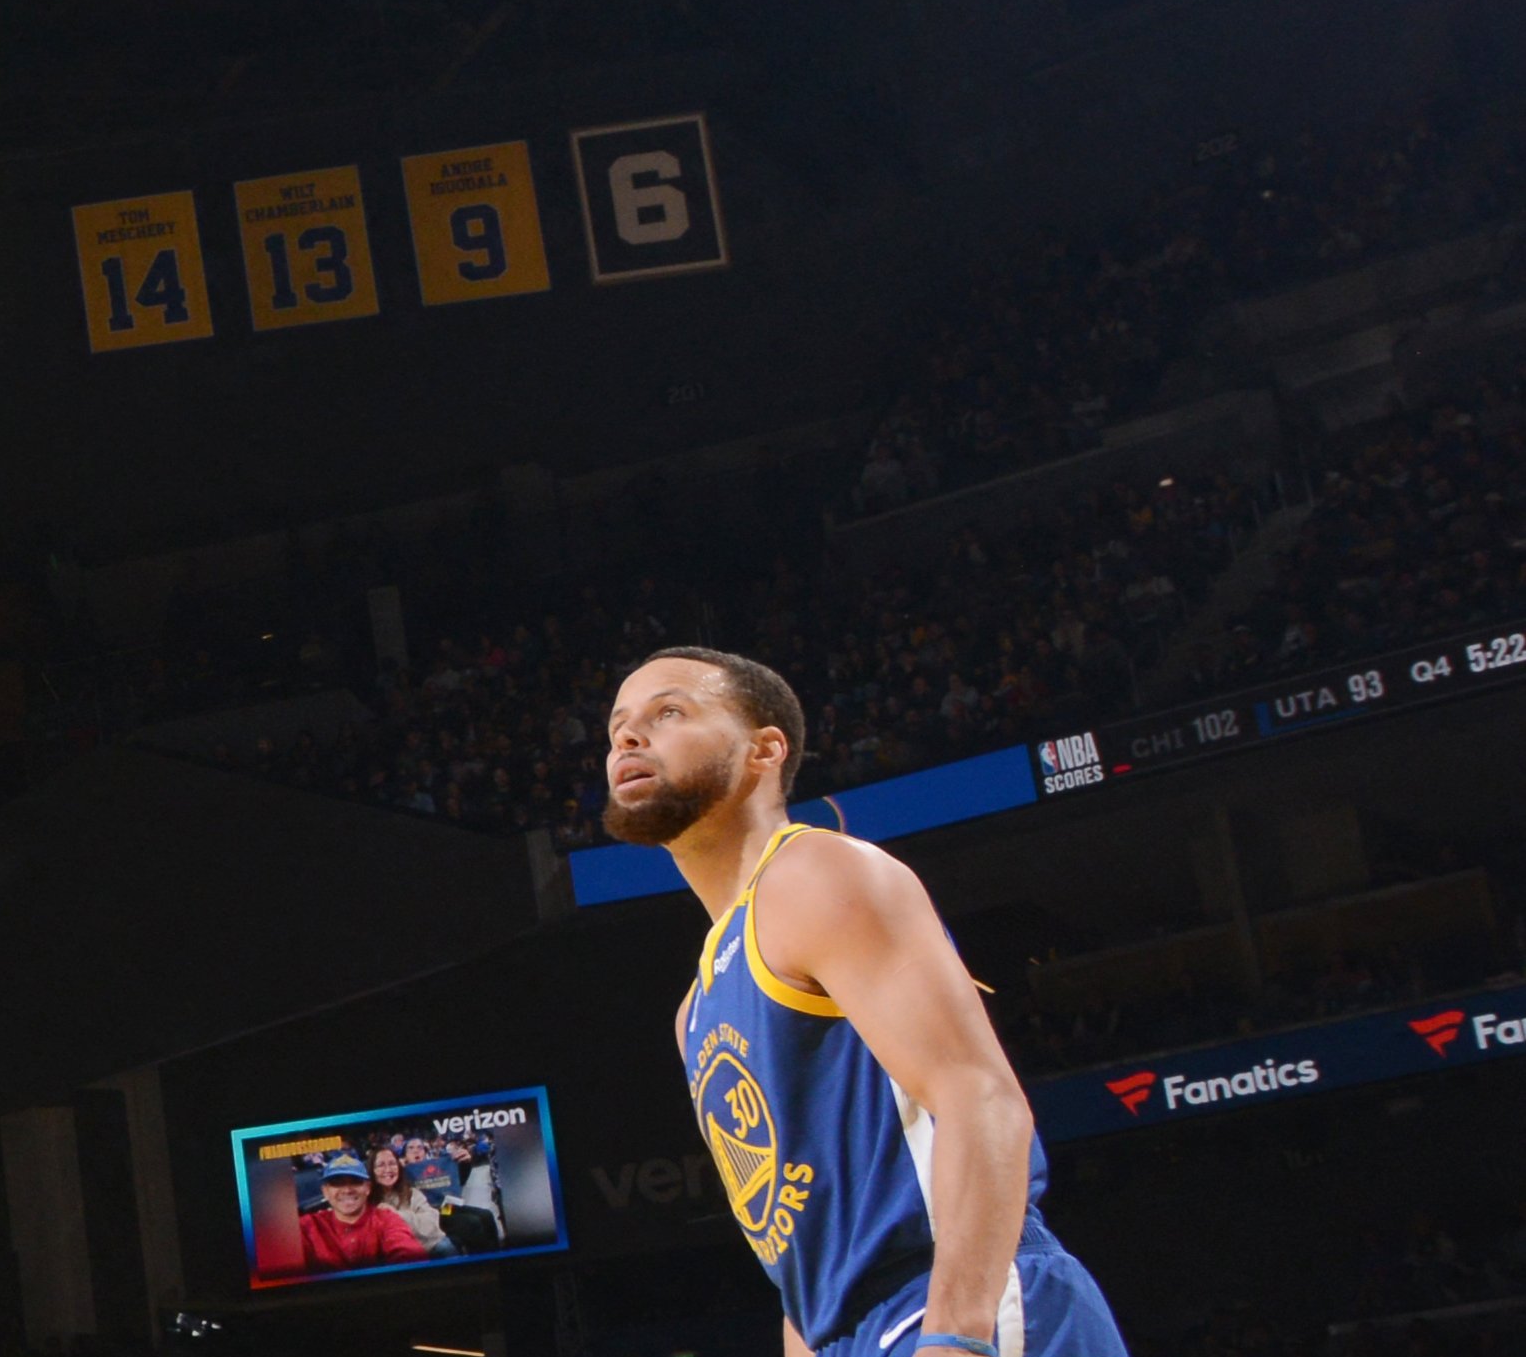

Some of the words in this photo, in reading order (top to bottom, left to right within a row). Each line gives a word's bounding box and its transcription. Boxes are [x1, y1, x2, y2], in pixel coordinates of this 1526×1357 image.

[441, 158, 493, 179] ANDRE
[245, 195, 355, 223] CHAMBERLAIN
[279, 183, 316, 201] WILT
[608, 150, 690, 245] 6
[118, 208, 150, 225] TOM
[449, 202, 507, 283] 9
[264, 225, 353, 310] 13
[102, 249, 189, 332] 14
[1192, 710, 1239, 743] 102
[1275, 690, 1337, 718] UTA
[1348, 670, 1384, 703] 93
[1044, 764, 1104, 794] SCORES
[719, 1023, 749, 1058] STATE
[1164, 1059, 1319, 1110] Fanatics
[433, 1103, 526, 1137] verizon
[724, 1078, 760, 1141] 30
